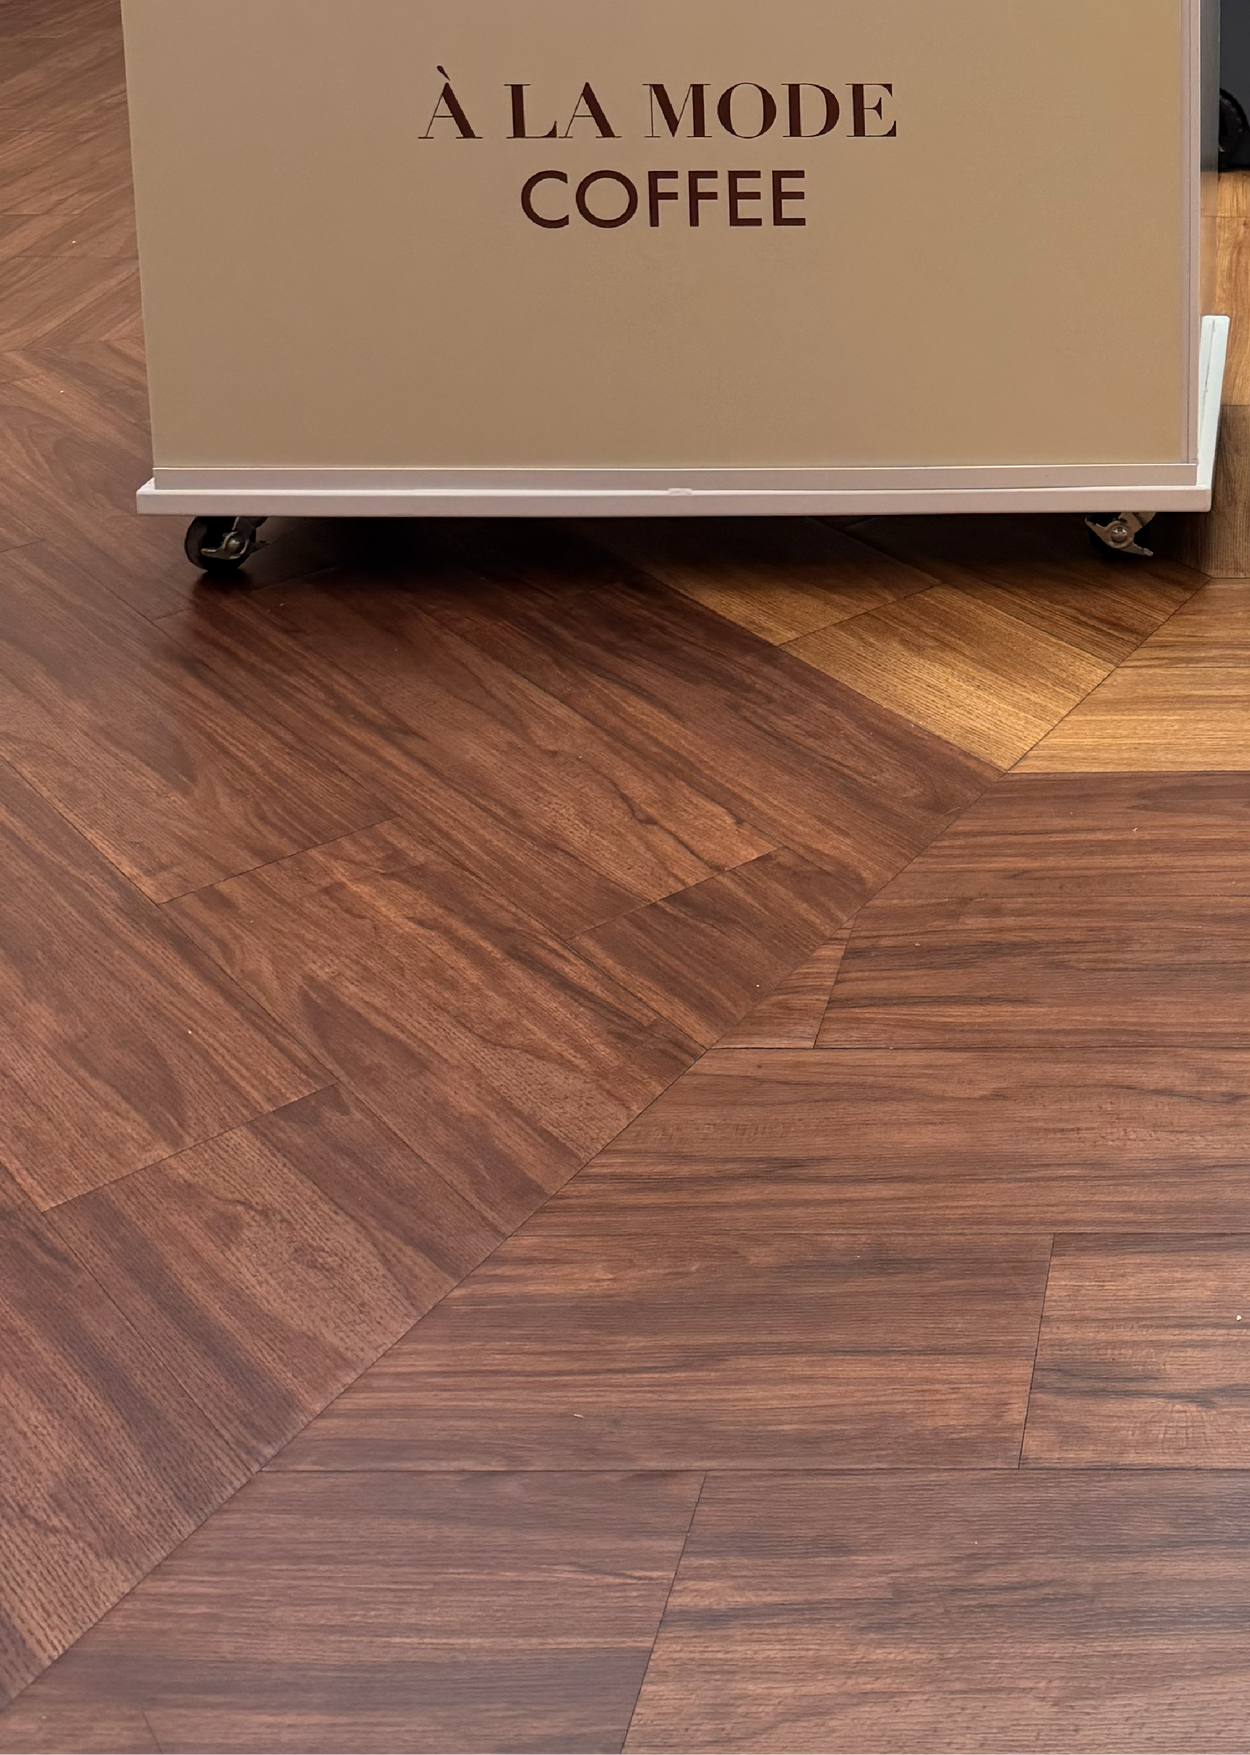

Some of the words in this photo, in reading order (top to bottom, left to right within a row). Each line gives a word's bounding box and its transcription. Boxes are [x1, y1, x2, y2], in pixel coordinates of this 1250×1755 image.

[418, 65, 483, 139] À
[504, 82, 622, 139] LA
[642, 82, 897, 139] MODE
[521, 170, 806, 229] COFFEE
